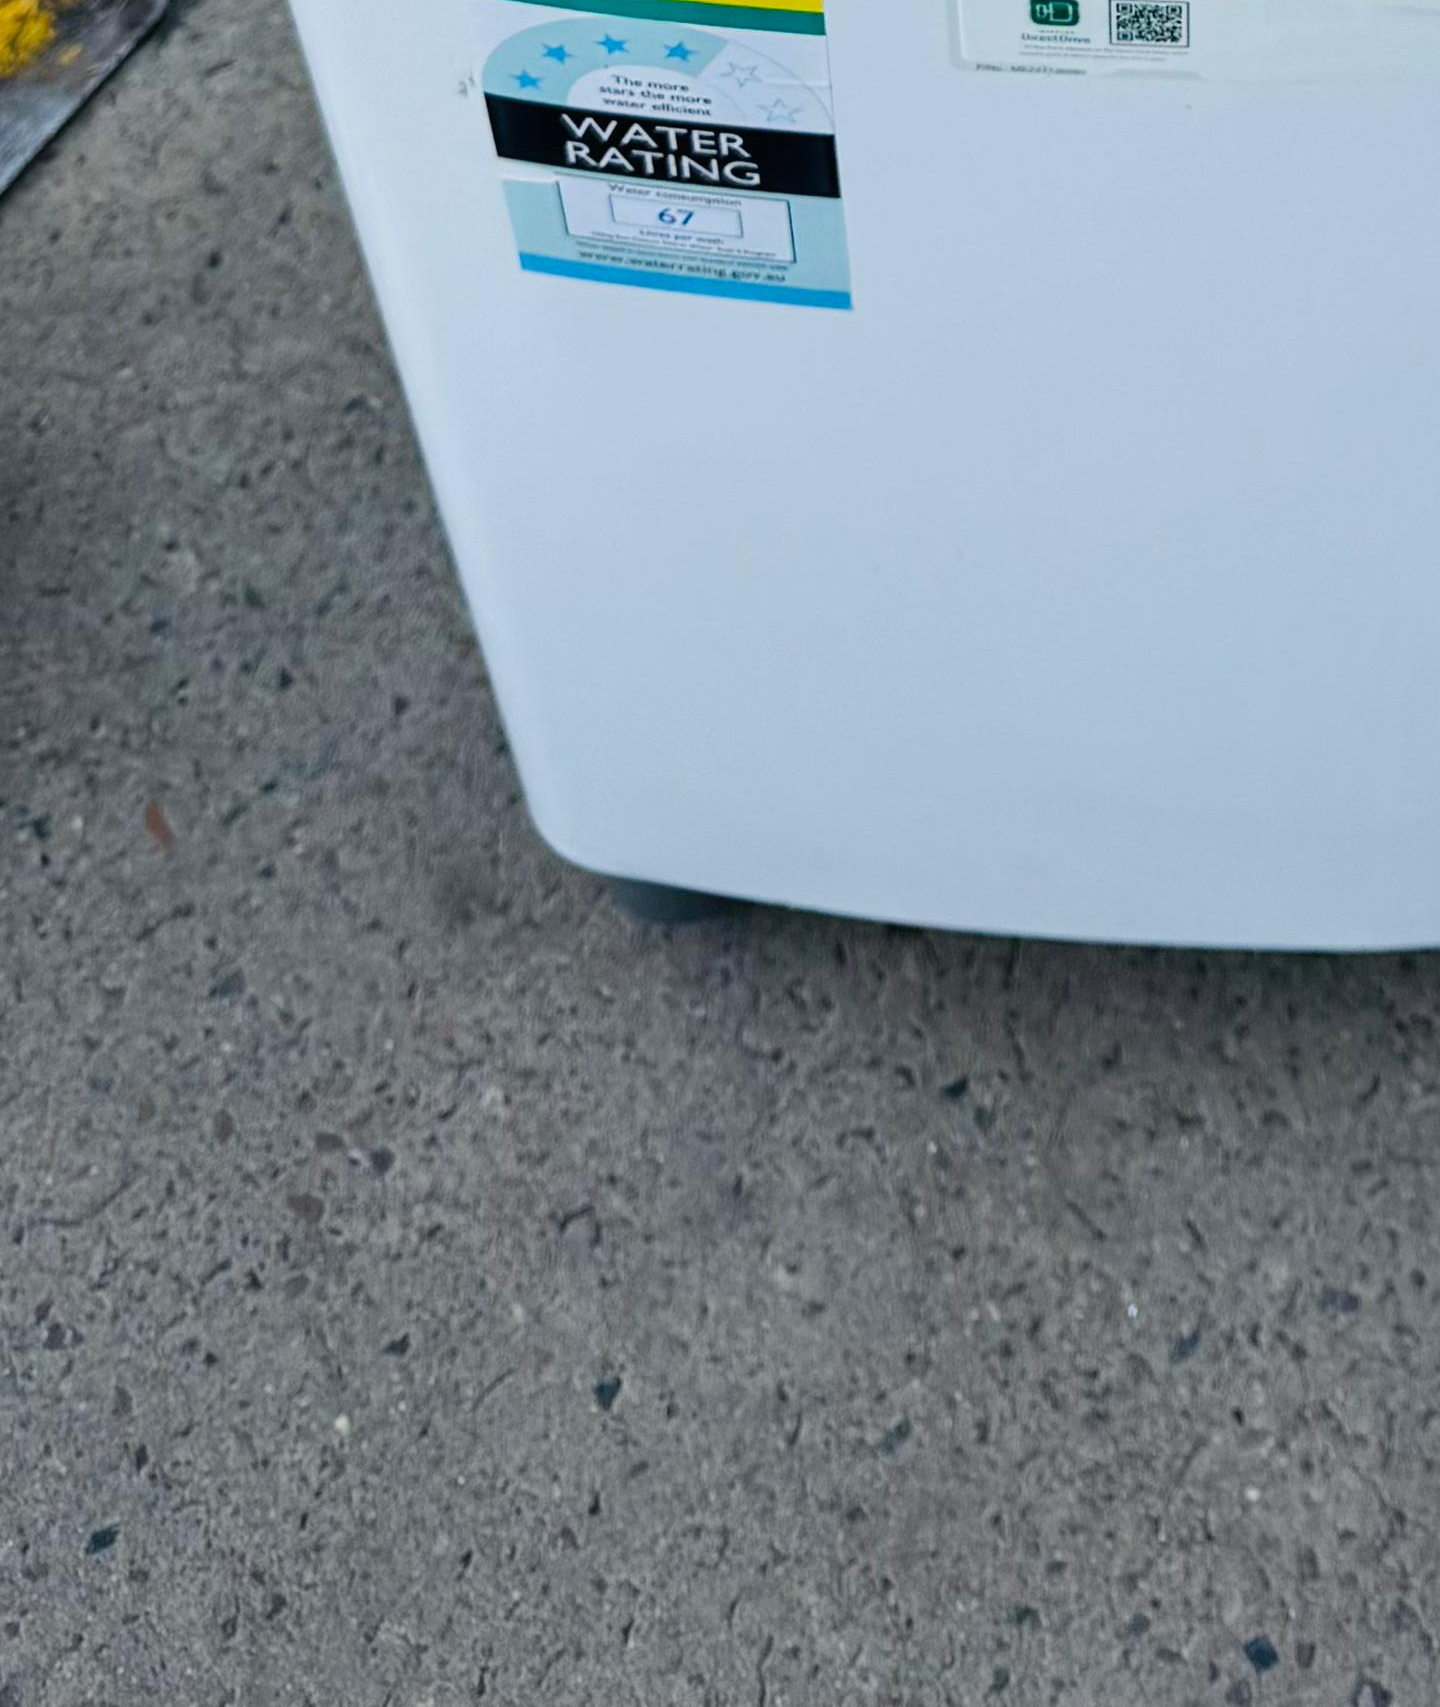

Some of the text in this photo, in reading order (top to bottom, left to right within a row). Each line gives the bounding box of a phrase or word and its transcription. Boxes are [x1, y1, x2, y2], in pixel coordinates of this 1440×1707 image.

[611, 74, 689, 91] The more
[599, 86, 712, 104] stars the more
[603, 97, 712, 116] water efficient
[561, 113, 751, 158] WATER
[565, 141, 760, 186] RATING
[658, 208, 695, 226] 67
